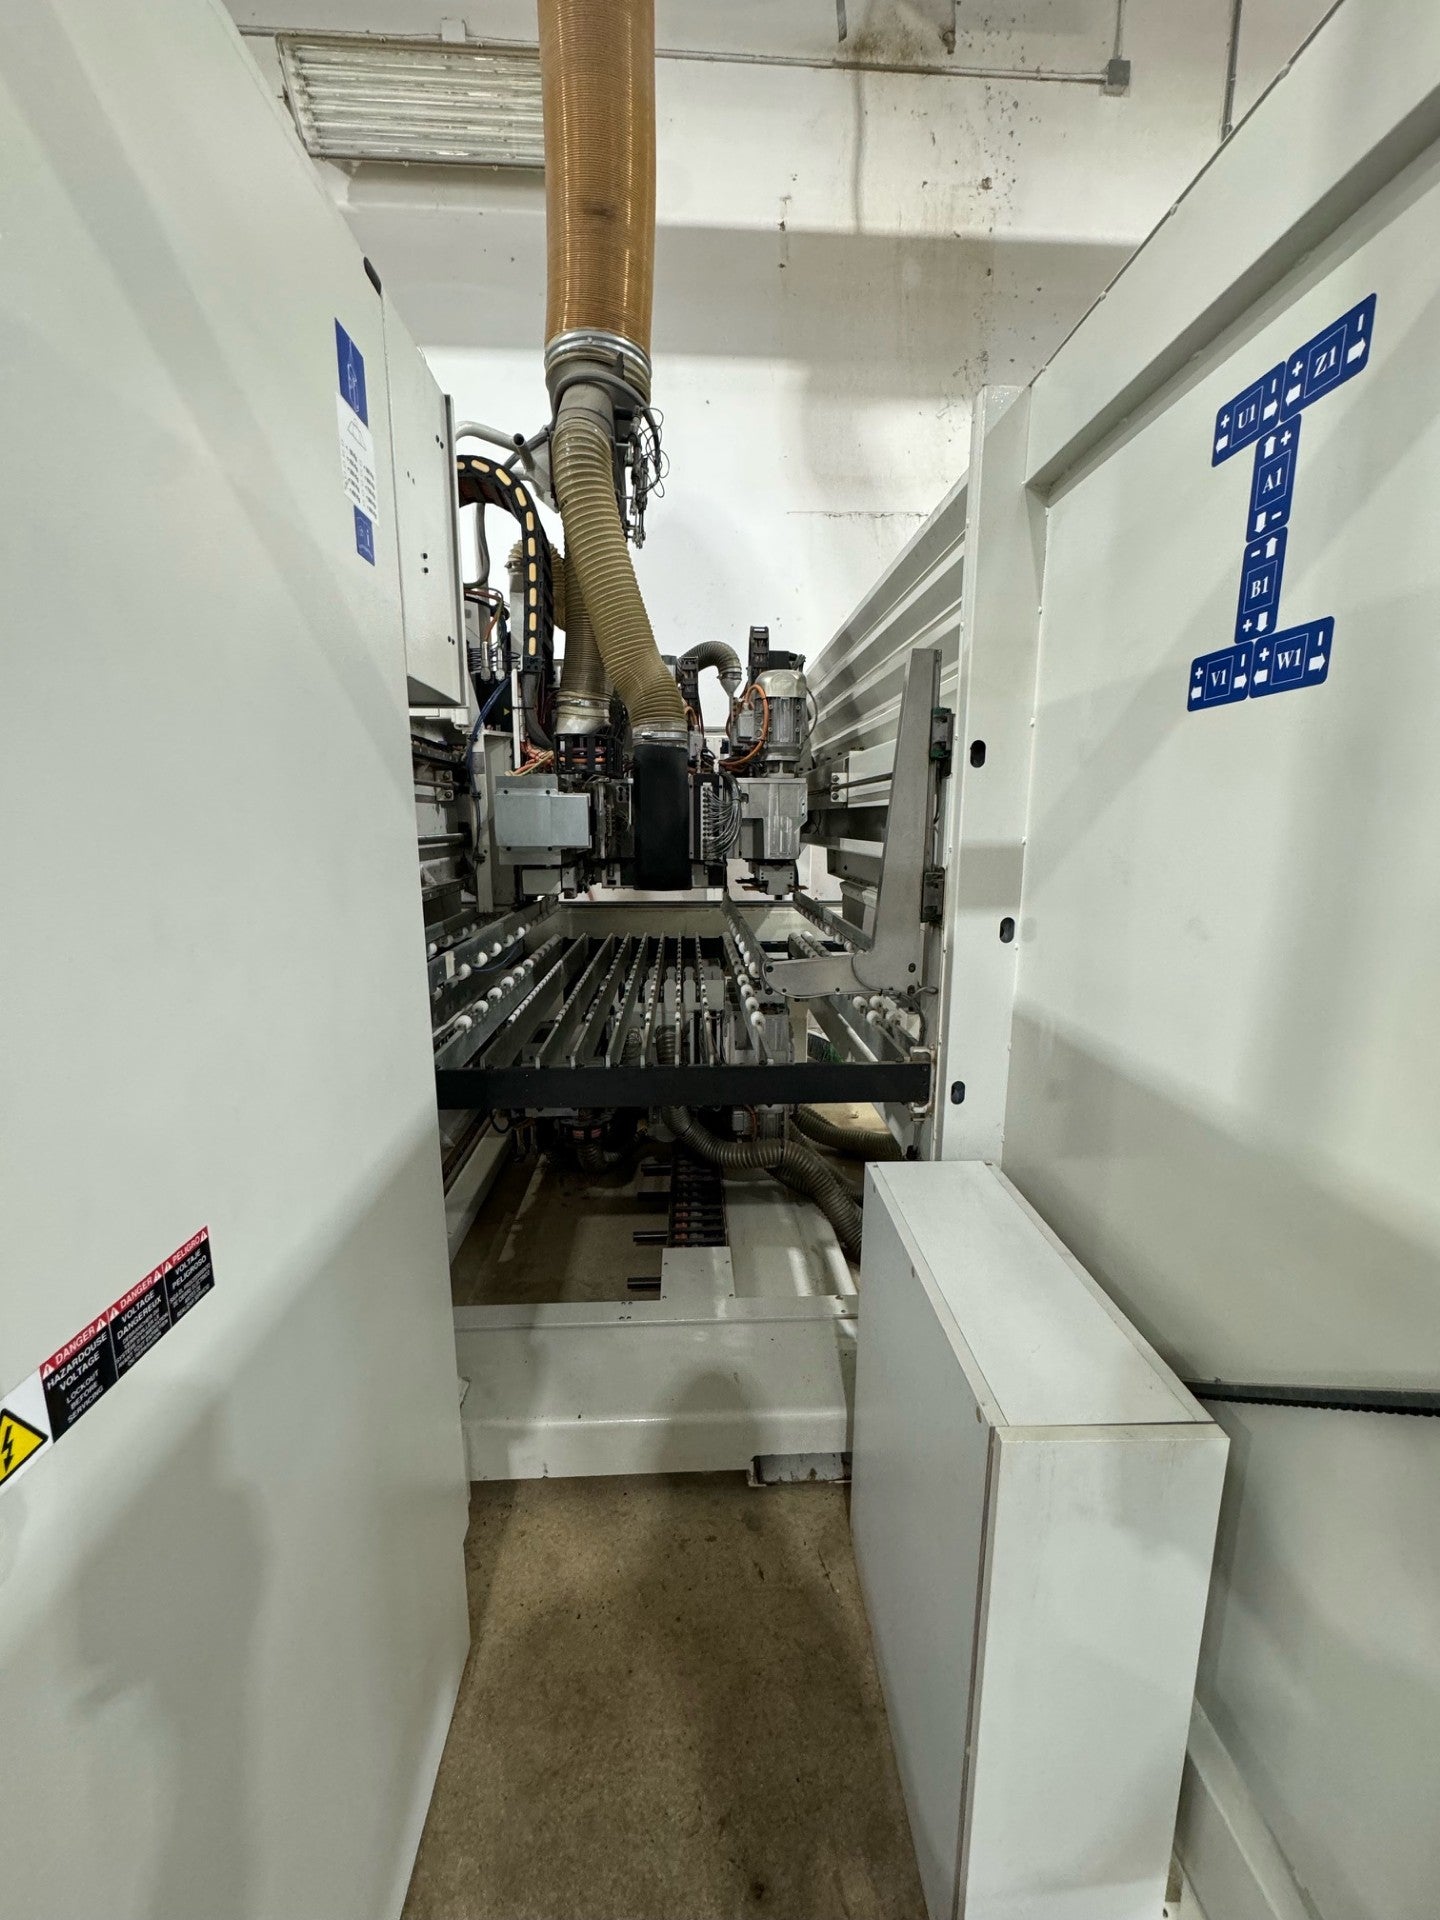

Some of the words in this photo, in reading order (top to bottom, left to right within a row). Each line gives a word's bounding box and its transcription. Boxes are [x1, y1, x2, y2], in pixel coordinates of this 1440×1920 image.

[1313, 346, 1336, 379] Z1
[1238, 404, 1256, 429] U1
[1262, 467, 1283, 494] A1
[1250, 576, 1269, 599] B1
[1277, 648, 1302, 669] W1
[1211, 669, 1227, 687] V1
[120, 1276, 153, 1309] DANGER
[122, 1289, 155, 1323] VOLTAGE
[117, 1295, 162, 1340] DANGEREUX
[47, 1331, 107, 1390] HAZARDOUSE
[55, 1325, 95, 1365] DANGER
[60, 1350, 100, 1391] VOLTAGE
[67, 1385, 104, 1423] SERVICING
[71, 1381, 98, 1410] BEFORE
